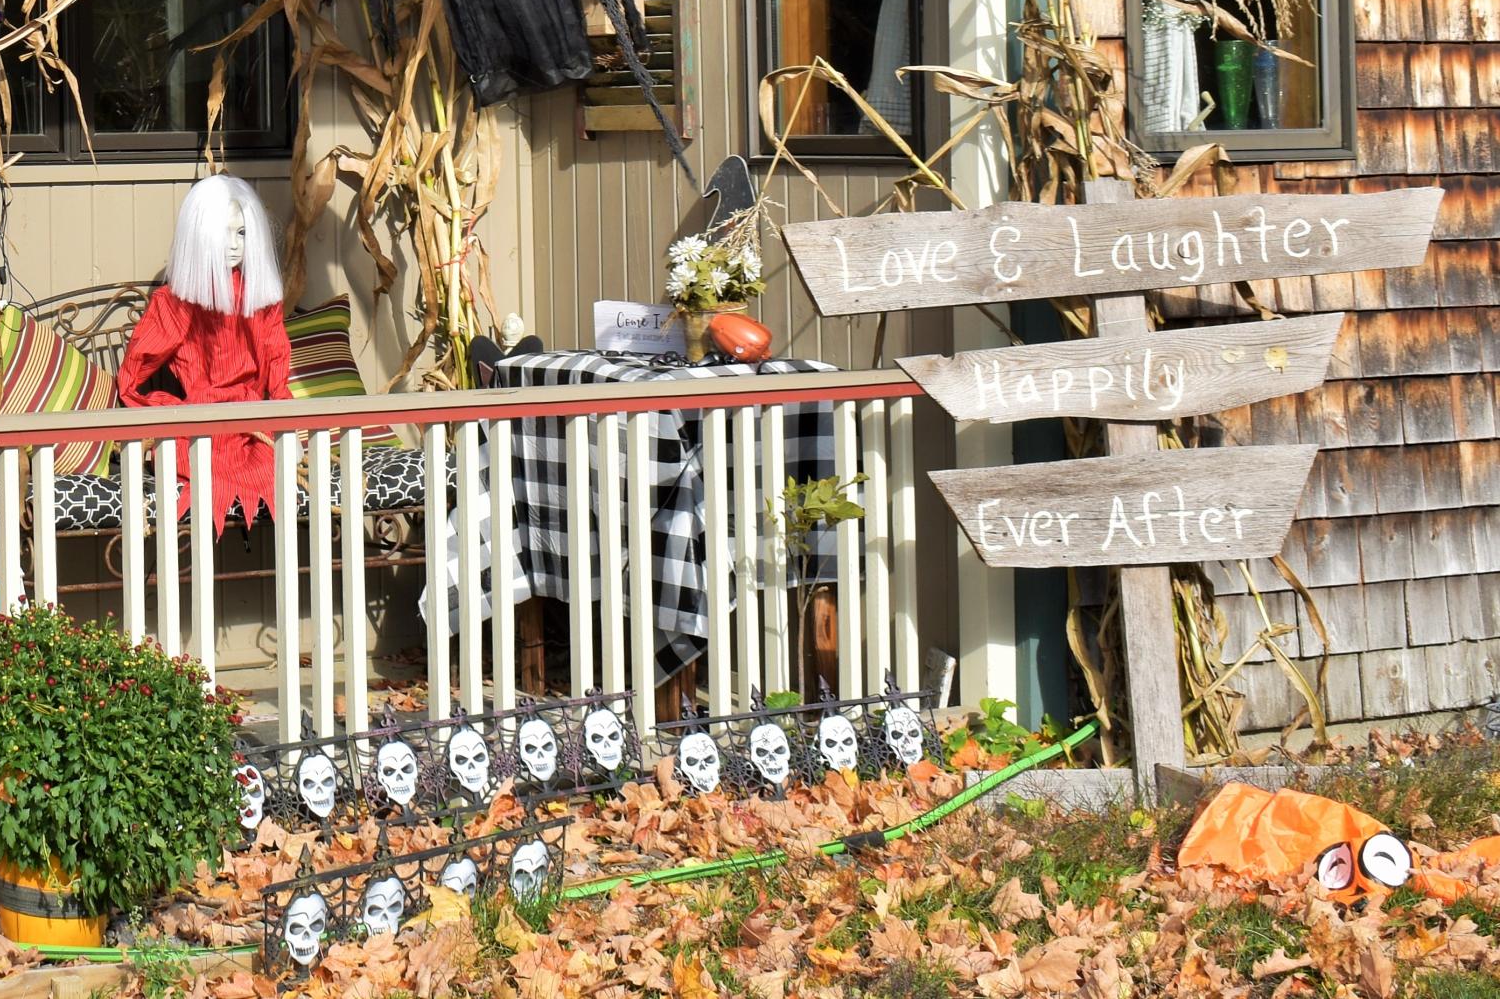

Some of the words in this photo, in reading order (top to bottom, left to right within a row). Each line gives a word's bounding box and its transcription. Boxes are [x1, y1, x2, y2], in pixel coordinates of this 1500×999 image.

[832, 235, 958, 292] Love
[989, 215, 1022, 294] &
[1066, 205, 1351, 282] Laughter
[616, 311, 649, 329] Come
[973, 348, 1185, 412] Happily
[977, 498, 1080, 551] Ever
[1101, 484, 1254, 551] After
